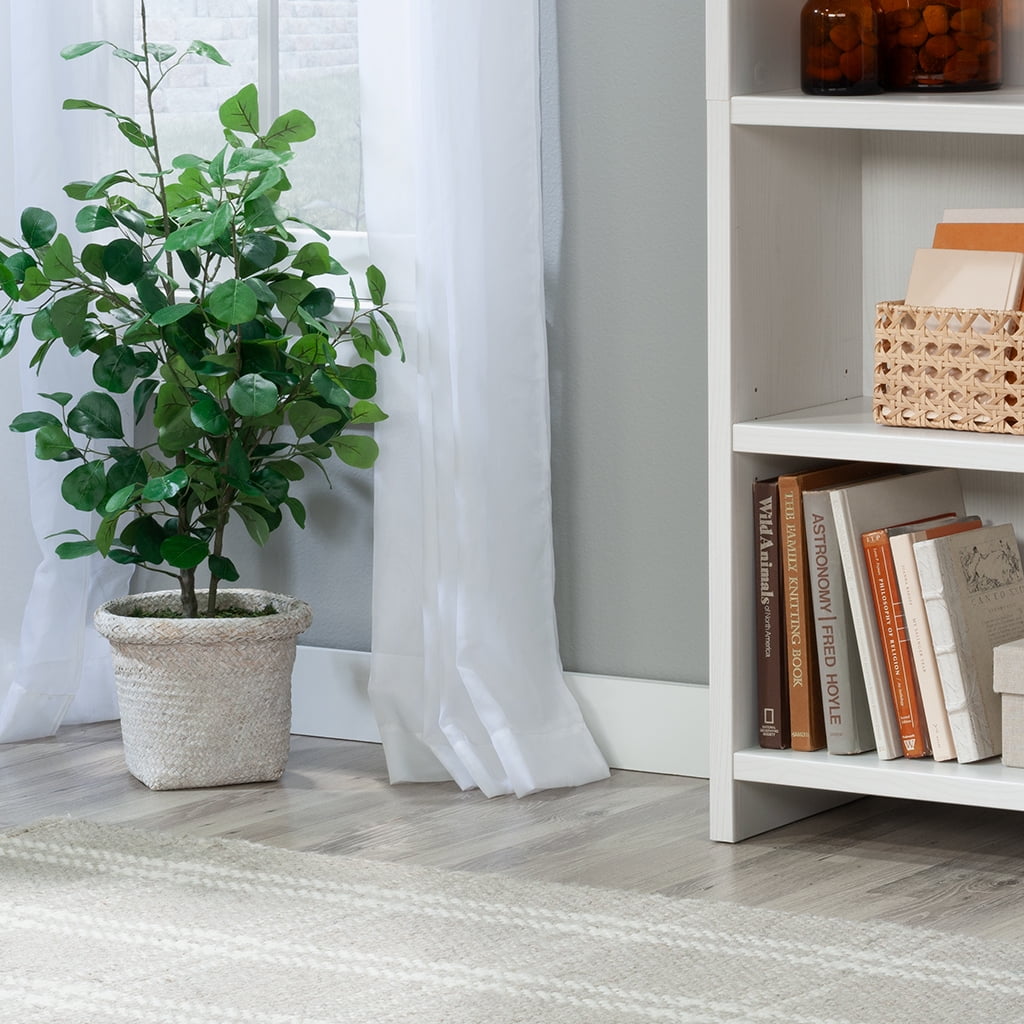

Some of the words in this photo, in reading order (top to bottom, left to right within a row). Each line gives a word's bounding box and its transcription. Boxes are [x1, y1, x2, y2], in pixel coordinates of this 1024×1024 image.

[759, 495, 774, 535] Wild
[784, 491, 795, 520] THE
[786, 524, 798, 572] FAMILY
[812, 513, 832, 613] ASTRONOMY
[760, 537, 774, 605] Animals
[764, 611, 772, 631] North
[788, 577, 801, 645] KNITTING
[878, 578, 891, 625] PHILOSOPHY
[764, 631, 772, 658] America
[822, 625, 836, 668] FRED
[887, 627, 894, 636] OF
[792, 649, 803, 688] BOOK
[889, 639, 900, 675] RELIGION
[825, 674, 841, 725] HOYLE
